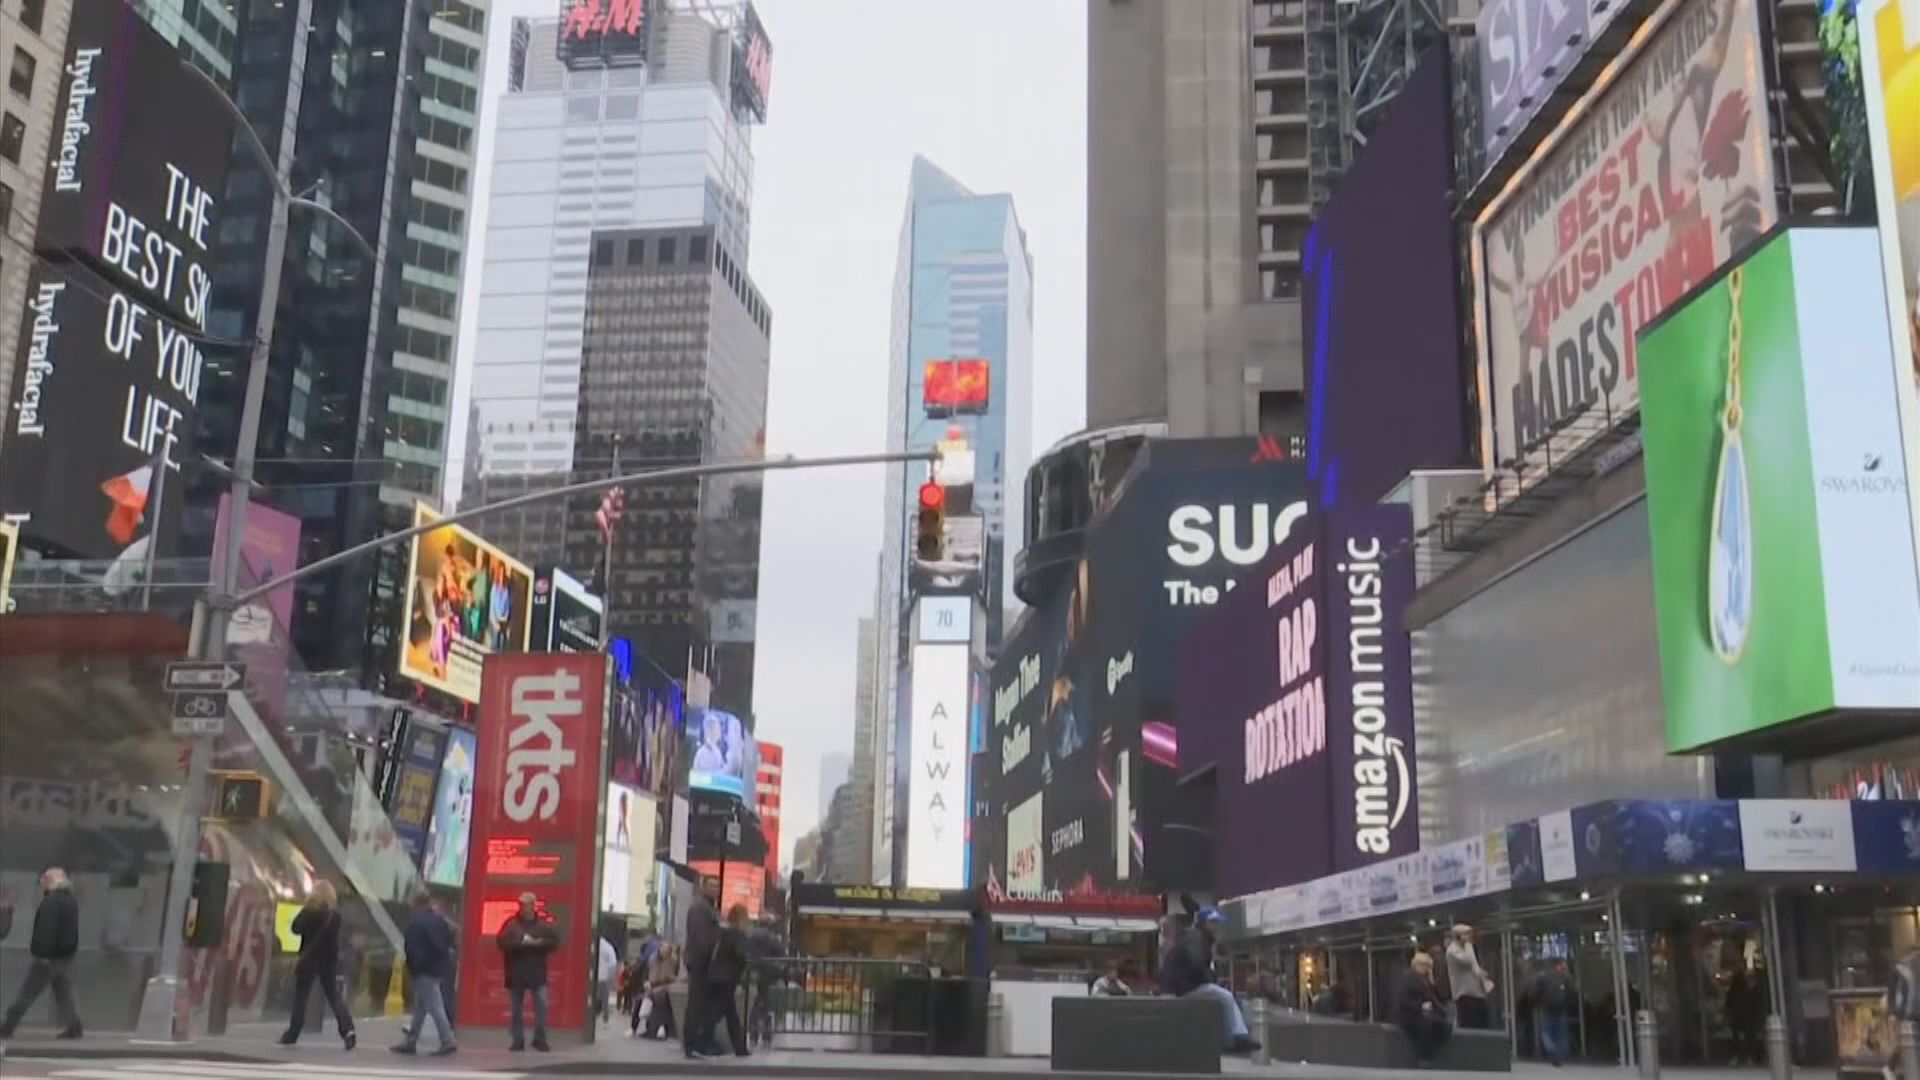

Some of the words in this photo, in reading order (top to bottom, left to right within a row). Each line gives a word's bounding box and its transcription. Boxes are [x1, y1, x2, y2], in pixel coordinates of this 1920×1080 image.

[54, 47, 102, 193] hydrafacial
[166, 162, 214, 250] THE
[1557, 126, 1643, 253] BEST
[102, 202, 182, 300] BEST
[1529, 172, 1685, 349] MUSICAL
[14, 281, 66, 438] hydrafacial
[105, 293, 147, 360] OF
[122, 385, 182, 473] LIFE
[935, 609, 953, 628] 70
[1163, 580, 1219, 605] The
[1279, 597, 1316, 688] RAP
[1337, 537, 1384, 672] music
[503, 668, 582, 822] tkts
[1245, 675, 1326, 784] ROTATION
[1352, 681, 1390, 854] amazon
[1051, 816, 1084, 857] SEPHORA
